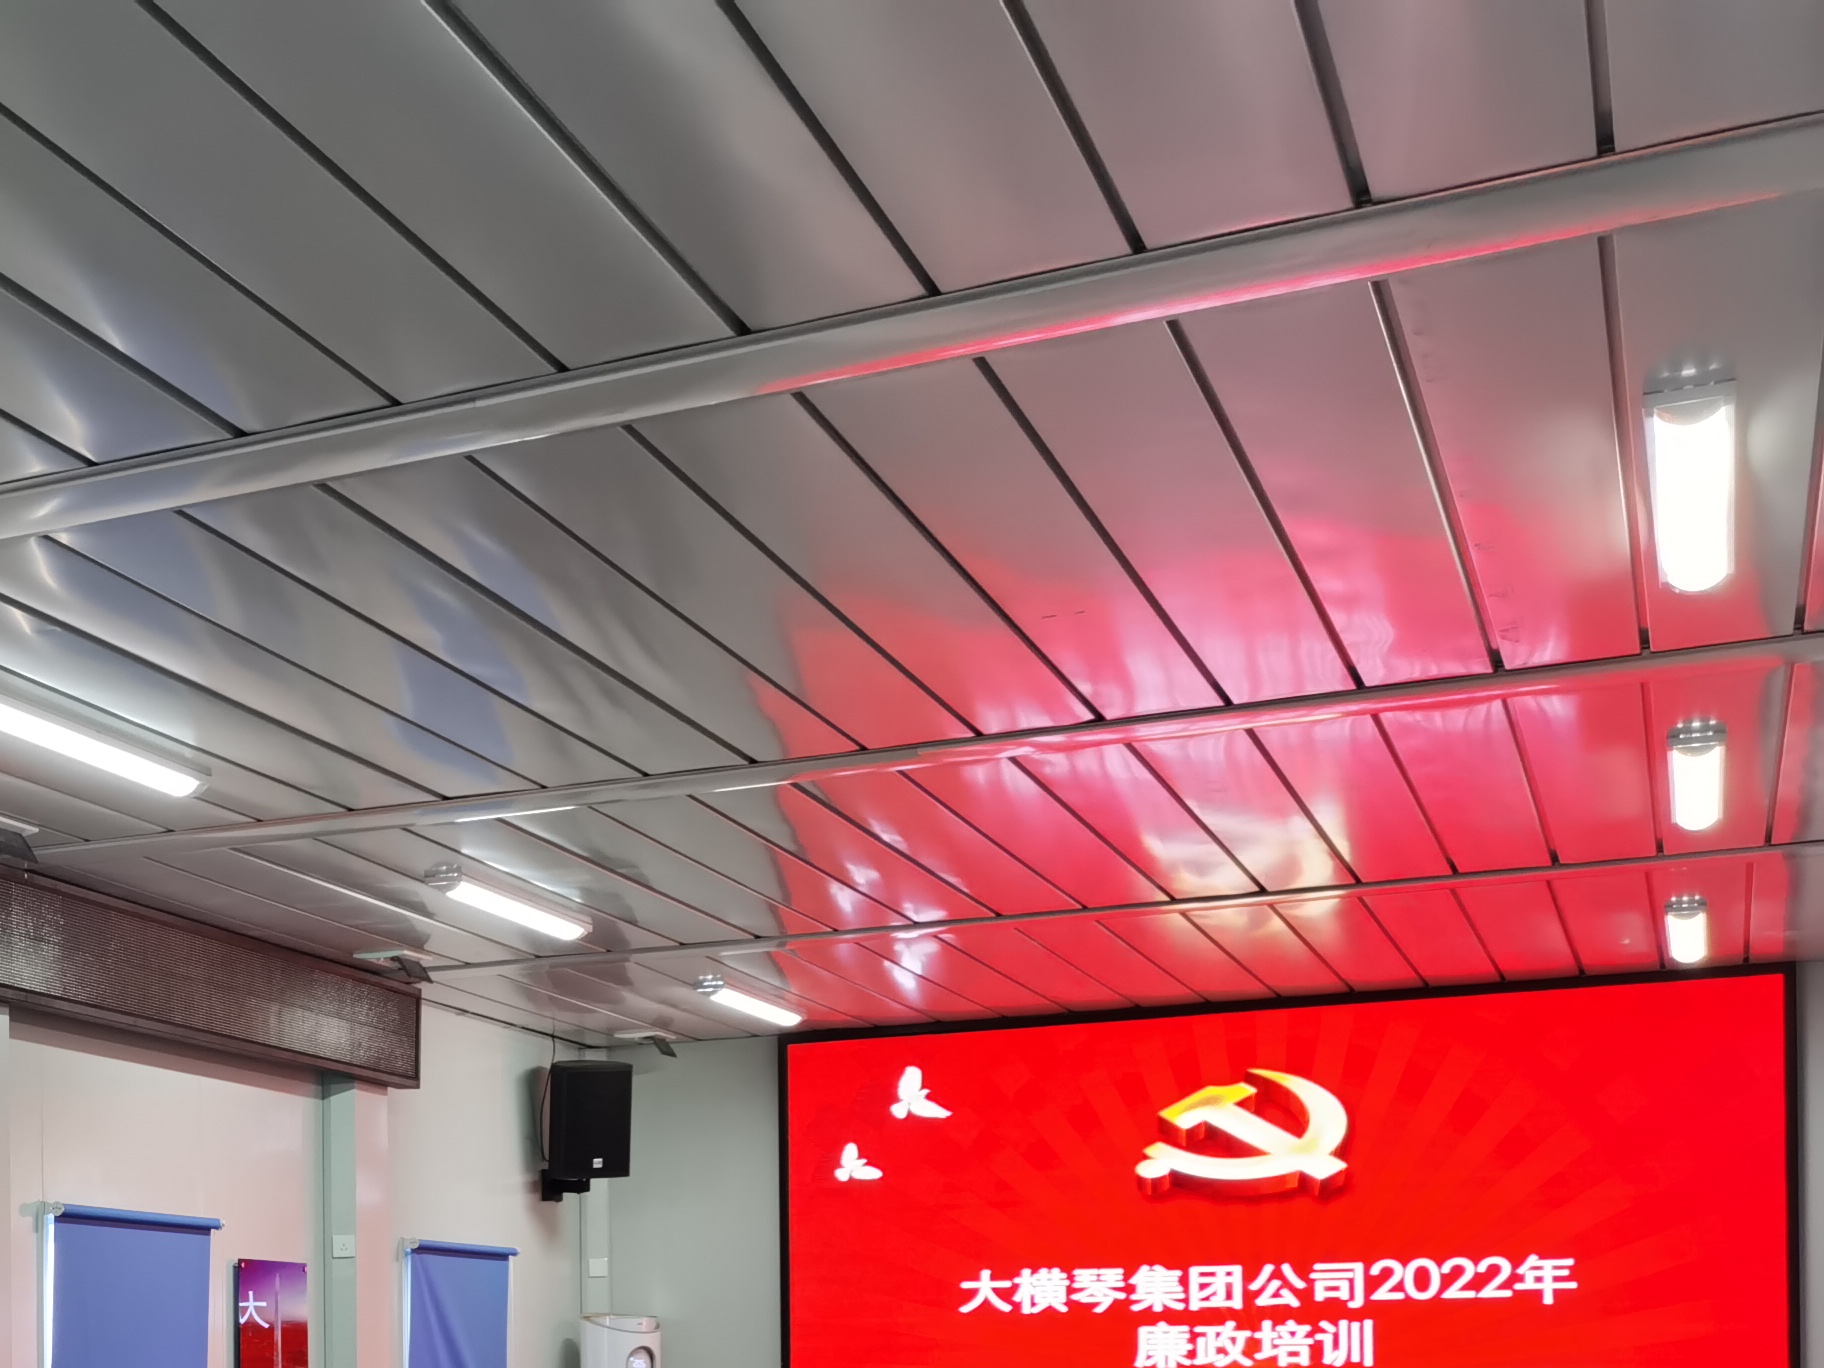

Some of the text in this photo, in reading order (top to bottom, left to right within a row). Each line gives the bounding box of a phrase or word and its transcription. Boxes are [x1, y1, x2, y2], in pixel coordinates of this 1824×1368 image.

[958, 1253, 1578, 1315] 大横琴集团公司2022年
[1133, 1319, 1374, 1368] 廉政培训
